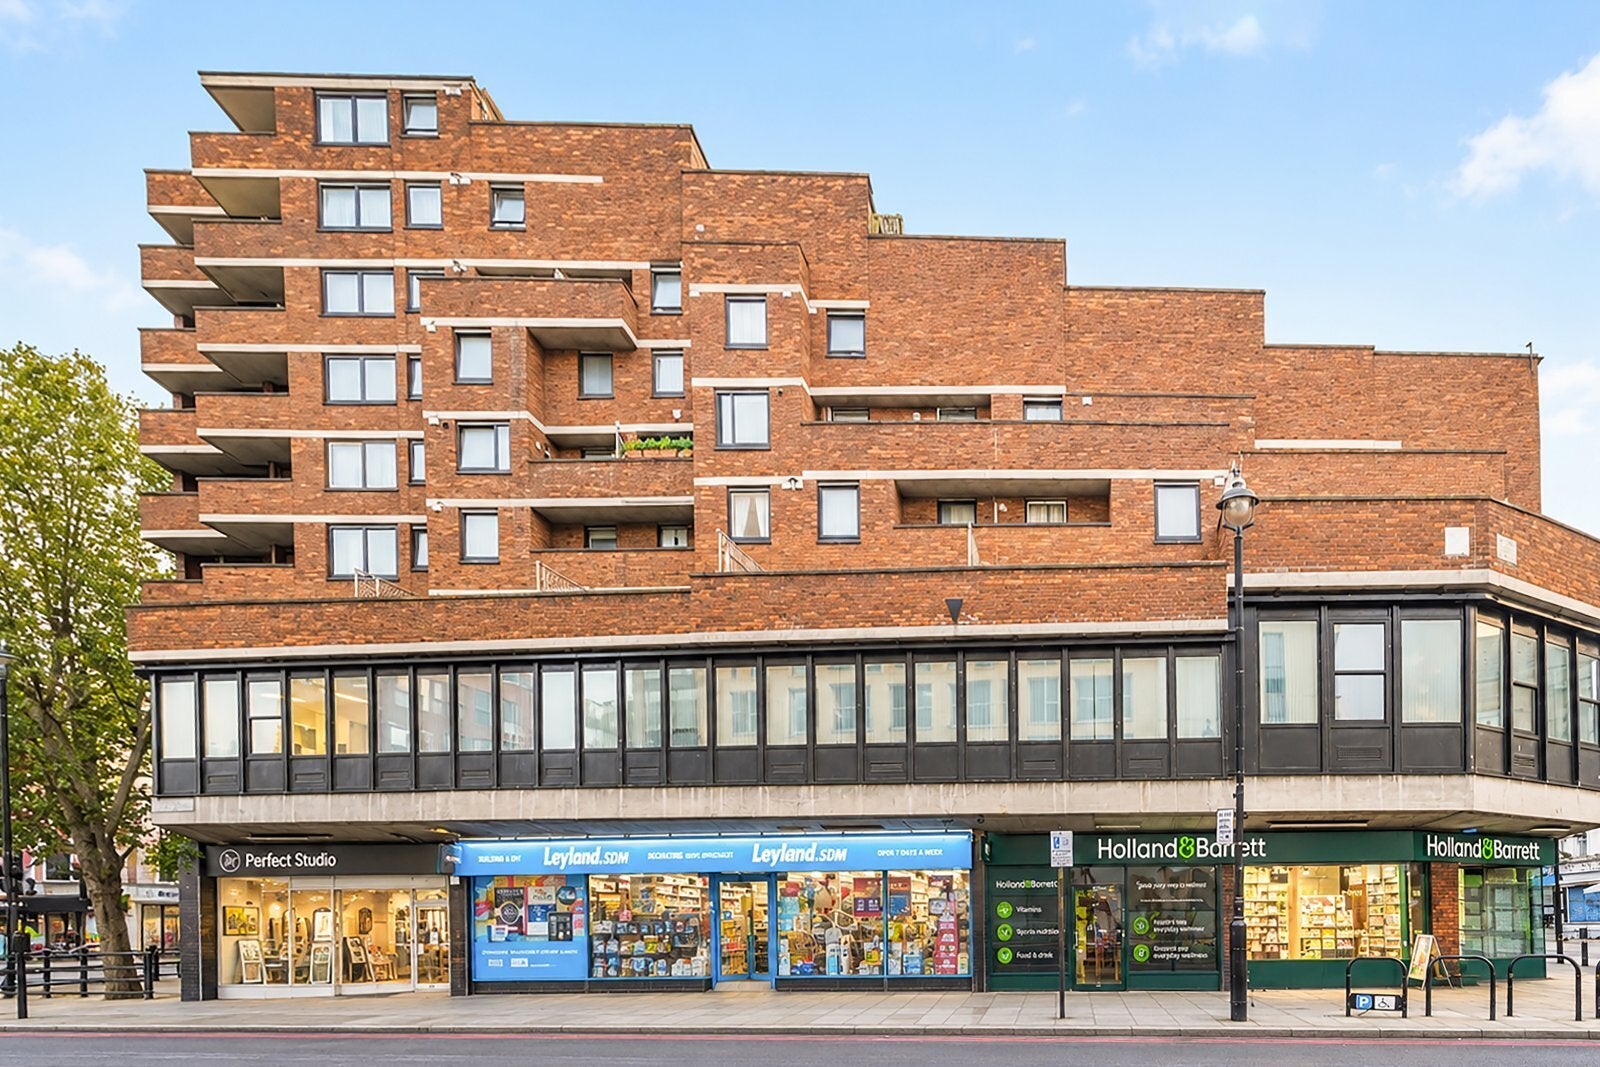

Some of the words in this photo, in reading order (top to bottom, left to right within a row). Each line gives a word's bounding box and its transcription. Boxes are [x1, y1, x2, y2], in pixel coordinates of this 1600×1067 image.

[245, 852, 292, 868] Perfect
[294, 852, 337, 867] Studio
[1360, 996, 1369, 1008] P
